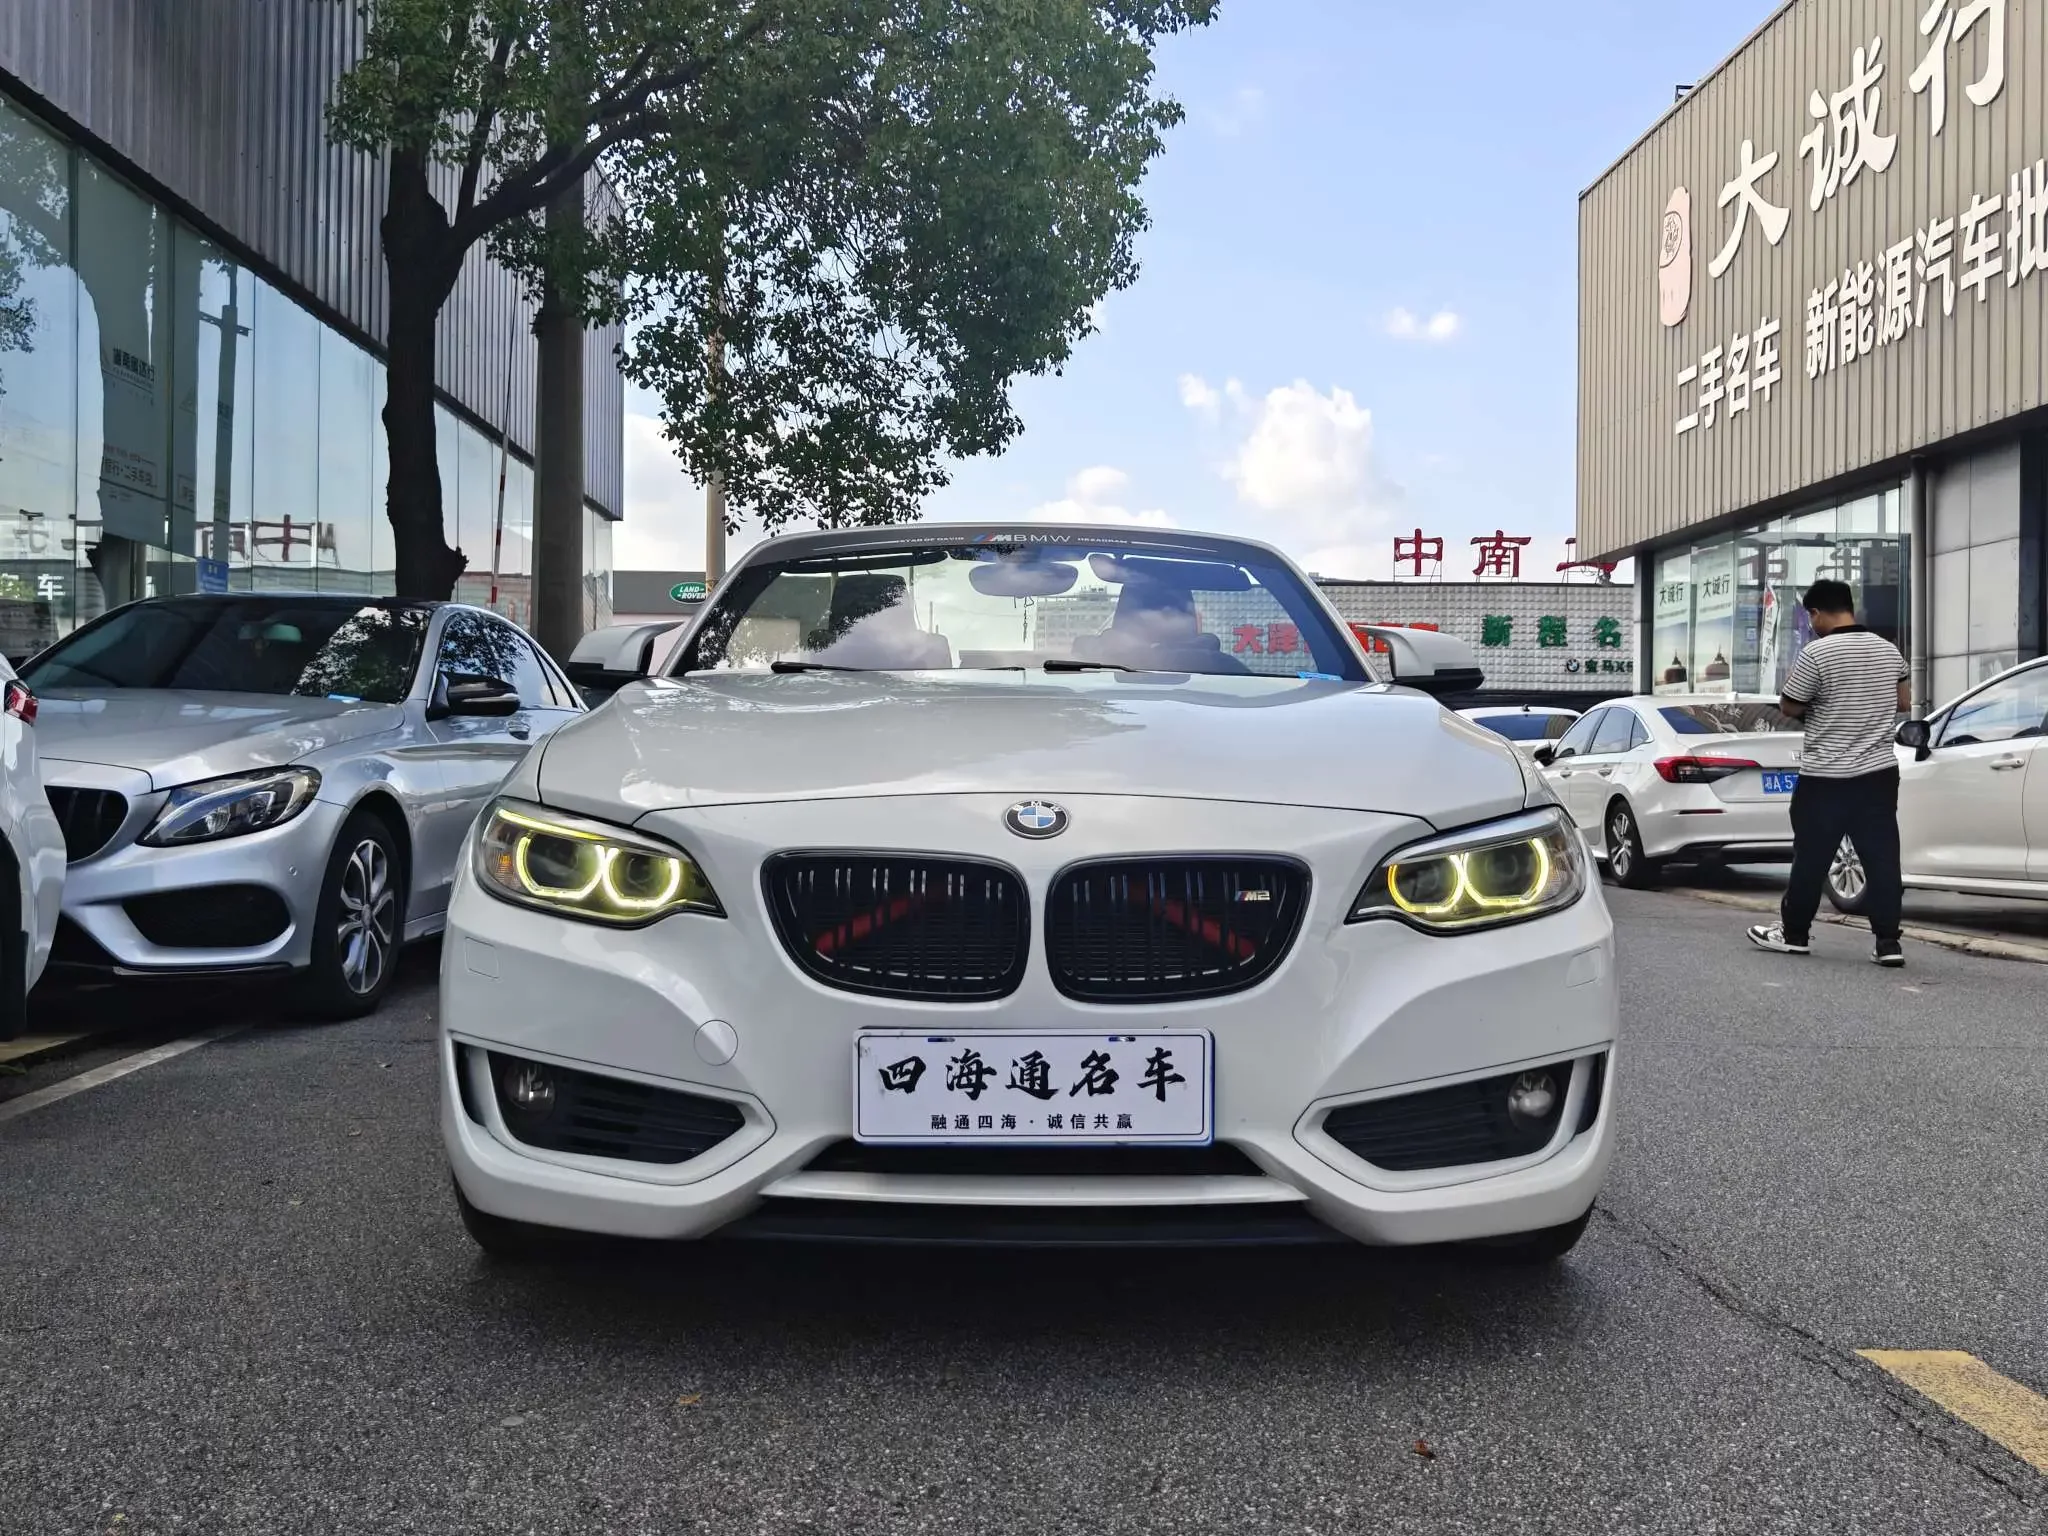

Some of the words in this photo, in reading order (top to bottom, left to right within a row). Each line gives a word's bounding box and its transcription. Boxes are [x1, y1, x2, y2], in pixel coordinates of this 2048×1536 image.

[1708, 0, 2005, 279] 大诚行
[1676, 316, 1782, 435] 二手名车
[1013, 534, 1071, 543] BMW
[1702, 573, 1731, 599] 大诚行
[878, 1046, 1187, 1102] 四海通名车
[931, 1113, 1133, 1130] 融通四海·诚信共赢
